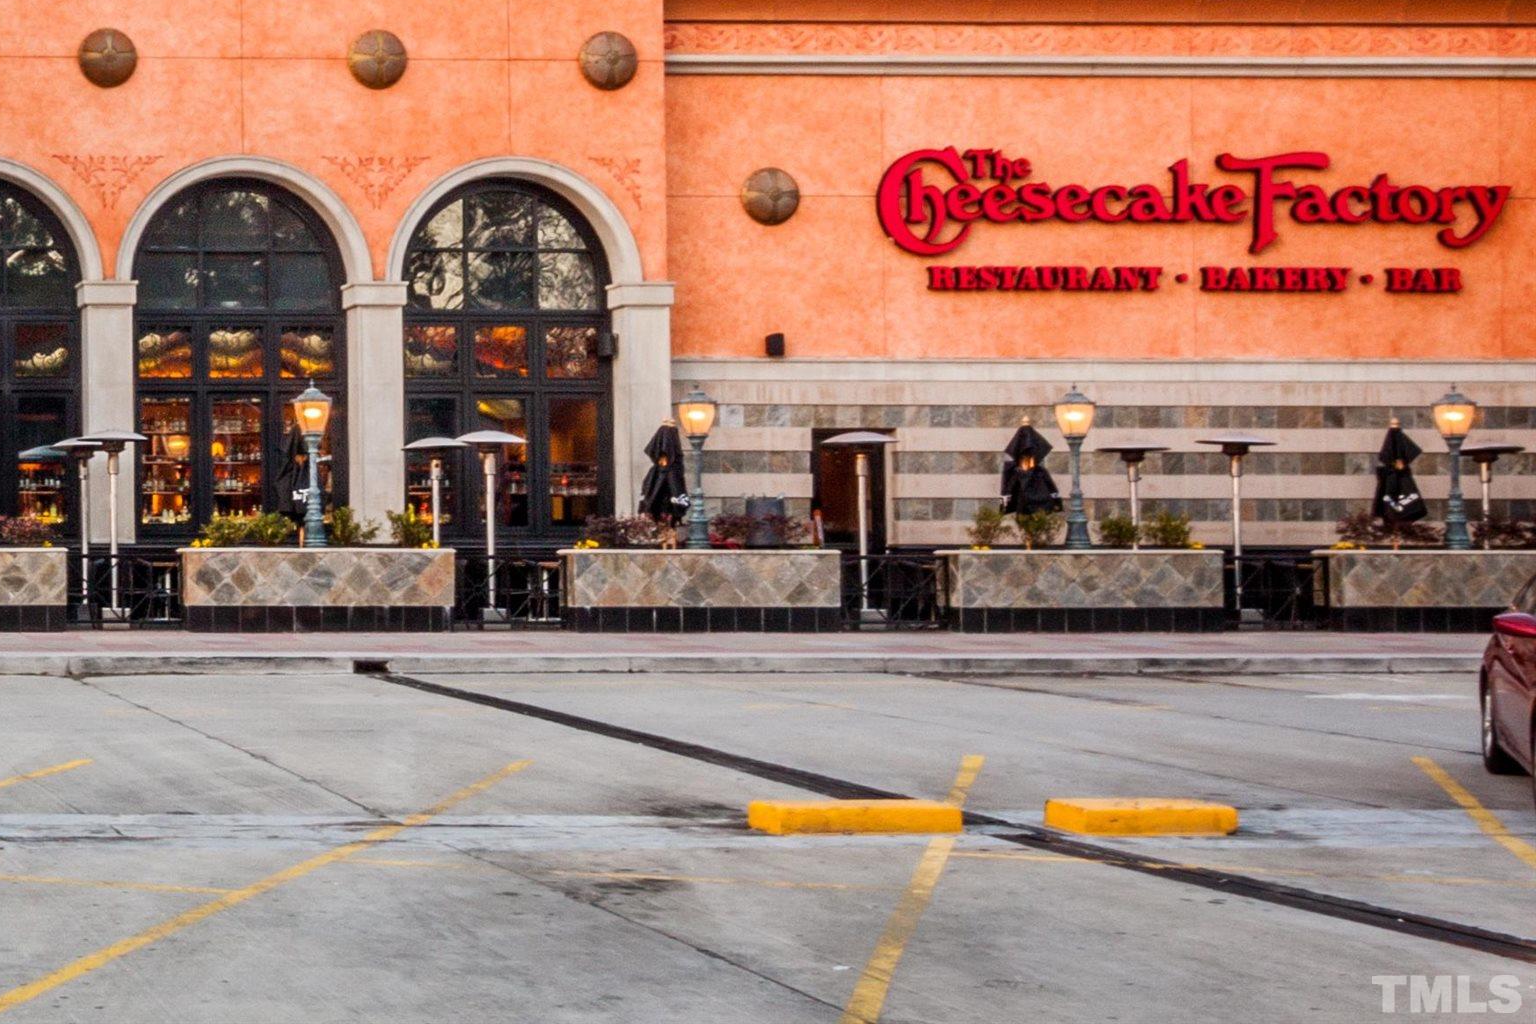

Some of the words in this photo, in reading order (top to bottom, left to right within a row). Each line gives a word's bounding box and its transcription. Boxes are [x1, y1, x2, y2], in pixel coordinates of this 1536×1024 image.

[963, 147, 1033, 182] The
[876, 145, 1249, 257] Cheesecake
[1215, 151, 1512, 255] Factory
[927, 264, 1163, 293] RESTAURANT
[1200, 264, 1353, 294] BAKERY
[1384, 265, 1463, 294] BAR
